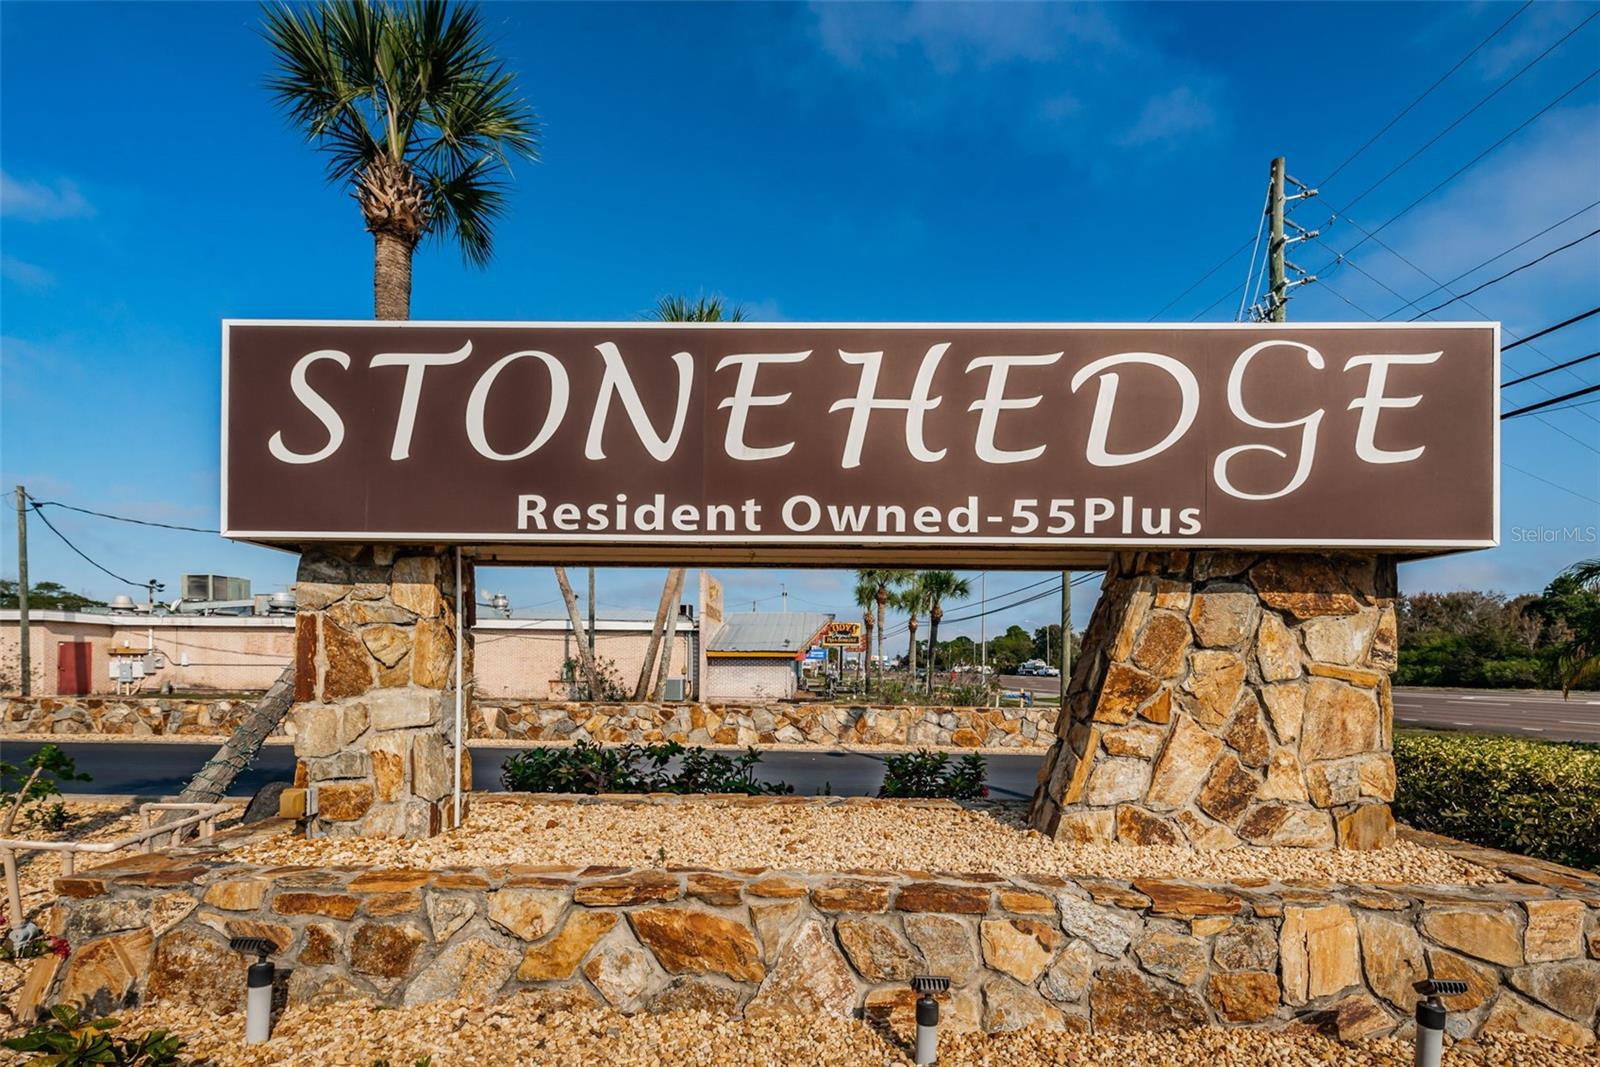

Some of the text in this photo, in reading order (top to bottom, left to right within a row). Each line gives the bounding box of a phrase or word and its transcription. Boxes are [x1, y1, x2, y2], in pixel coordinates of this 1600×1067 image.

[269, 340, 1443, 501] STONEHEDGE
[518, 494, 1202, 535] Resident Owned-55Plus
